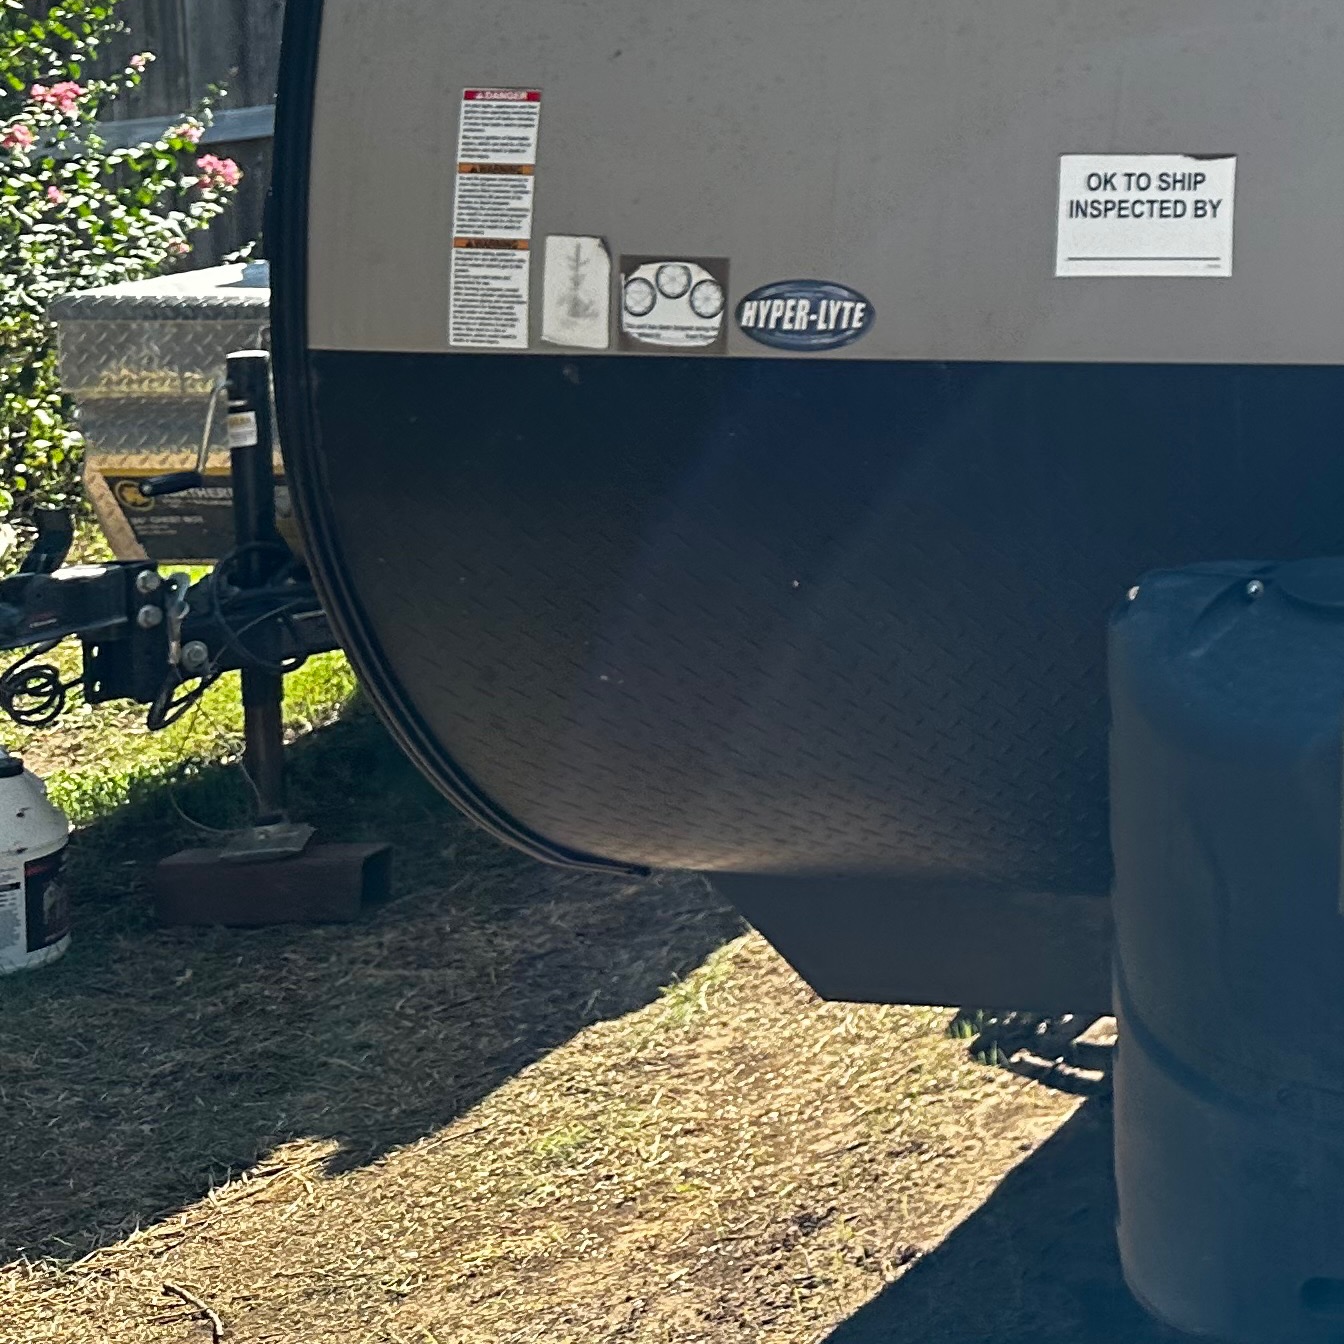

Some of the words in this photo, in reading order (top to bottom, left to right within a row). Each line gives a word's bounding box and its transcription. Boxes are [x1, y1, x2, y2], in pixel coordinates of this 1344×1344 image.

[1086, 172, 1118, 192] OK
[1122, 172, 1151, 192] TO
[1157, 172, 1207, 192] SHIP
[1068, 199, 1187, 219] INSPECTED
[1193, 198, 1223, 219] BY
[741, 298, 867, 331] HYPER-LYTE
